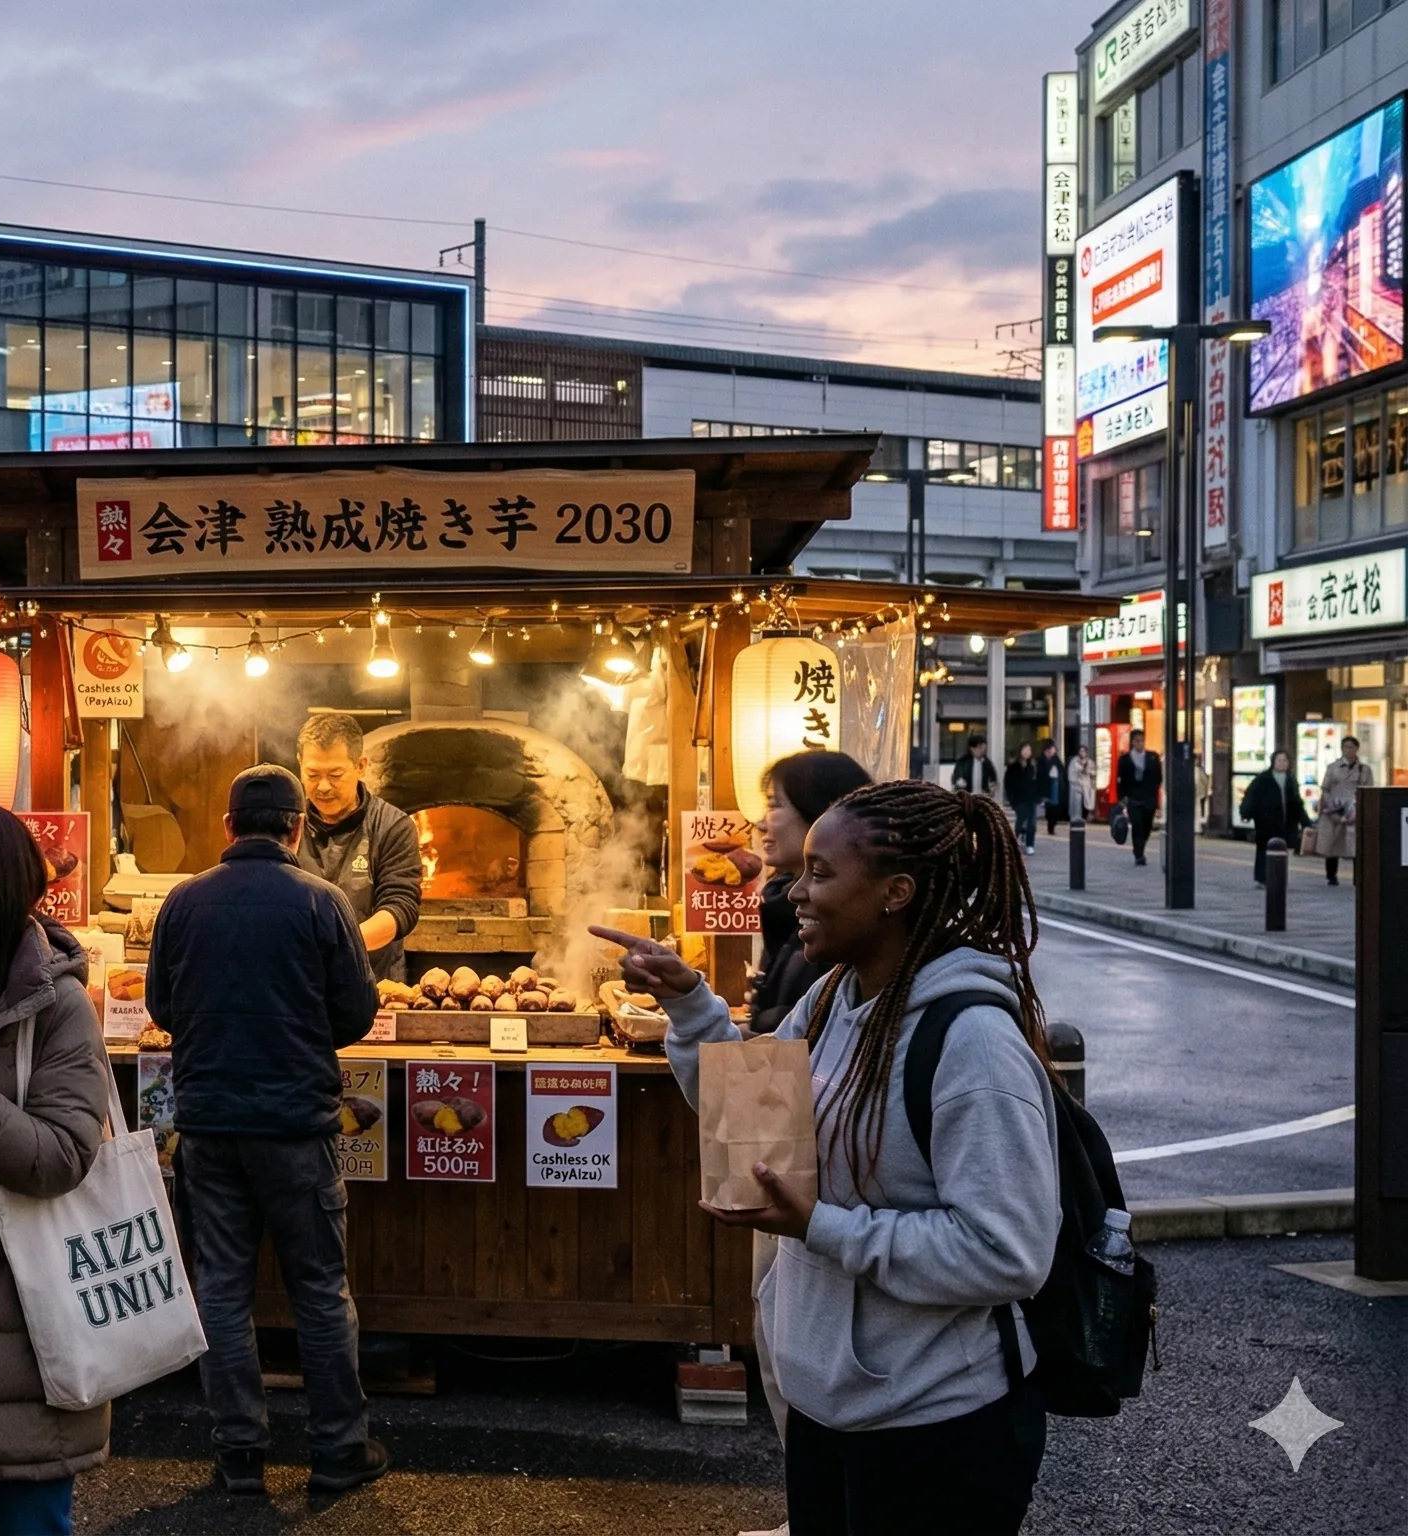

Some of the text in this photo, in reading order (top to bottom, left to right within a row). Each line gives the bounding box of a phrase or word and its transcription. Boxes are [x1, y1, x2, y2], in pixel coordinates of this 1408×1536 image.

[99, 505, 127, 556] 熱々
[137, 497, 672, 556] 会津 熟成焼き芋 2030
[78, 683, 139, 693] Cashless OK
[85, 696, 133, 707] (PayAizu)
[691, 890, 765, 910] 紅はるか
[705, 911, 761, 929] 500円
[417, 1136, 484, 1154] 紅はるか
[424, 1156, 479, 1175] 500円
[533, 1153, 610, 1166] Cashless OK
[64, 1206, 166, 1283] AIZU
[76, 1256, 183, 1329] UNIV.
